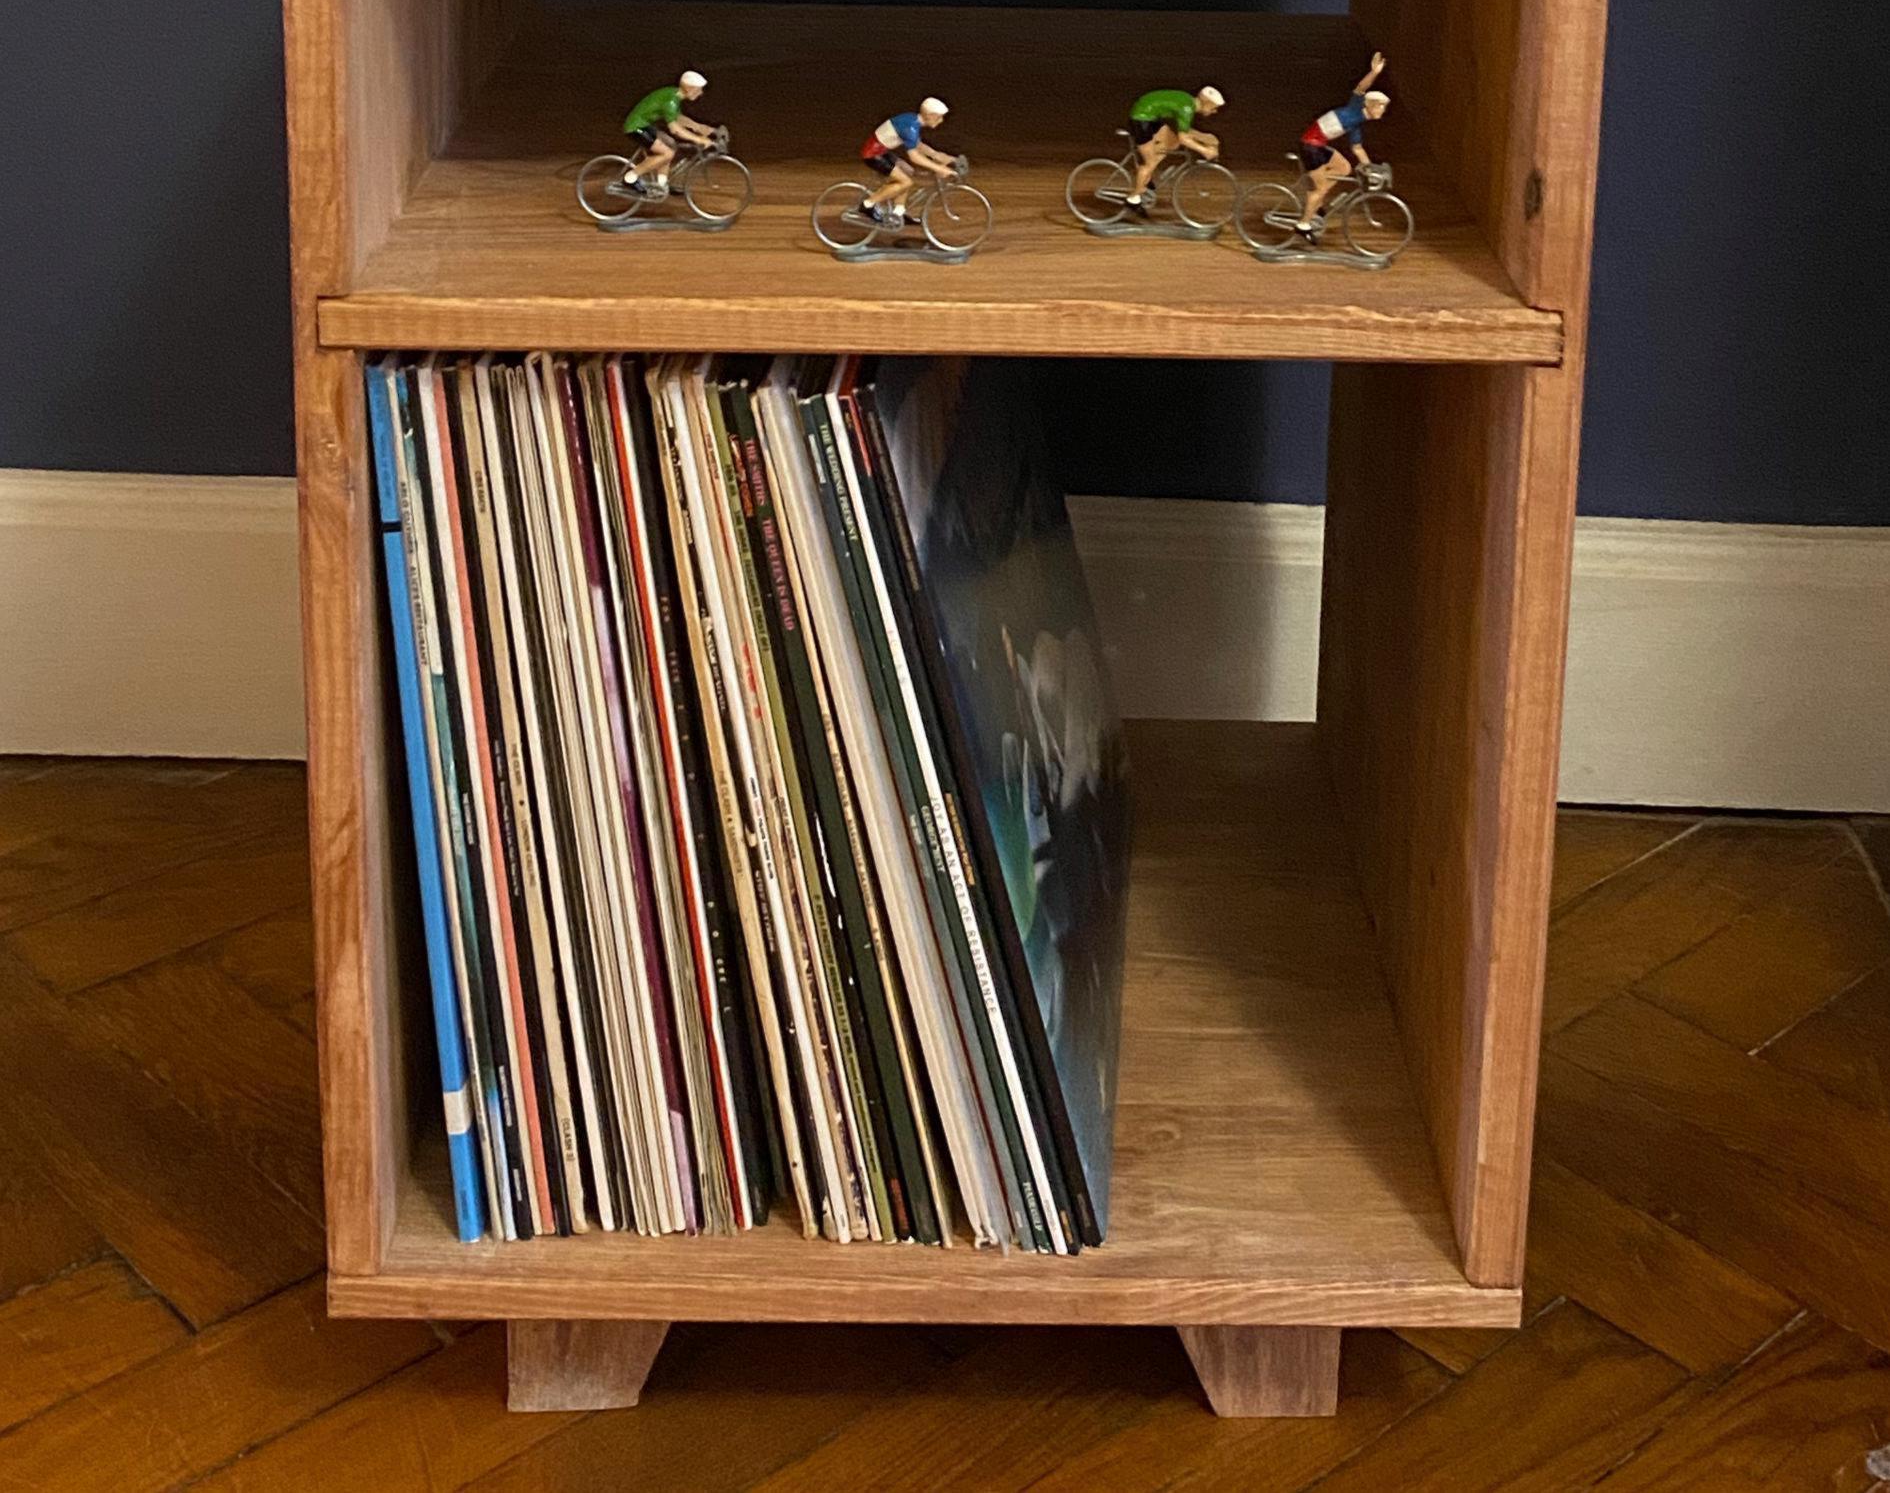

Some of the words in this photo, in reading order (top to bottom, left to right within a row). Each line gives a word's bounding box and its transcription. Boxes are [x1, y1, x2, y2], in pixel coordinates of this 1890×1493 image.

[745, 438, 757, 460] THE
[751, 463, 766, 506] SMITHS
[819, 424, 829, 445] THE
[825, 445, 846, 494] WEDDING
[839, 494, 859, 541] PRESENT
[762, 517, 774, 540] THE
[766, 542, 784, 583] QUEEN
[780, 597, 794, 631] DEAD
[721, 785, 732, 815] CLASH
[513, 759, 522, 786] CLASH
[521, 818, 531, 853] LONDON
[527, 853, 537, 888] CALLING
[920, 805, 937, 844] GEORGE
[933, 844, 946, 873] BEST
[930, 795, 945, 819] JOY
[939, 827, 951, 844] AS
[945, 851, 955, 870] AN
[951, 873, 967, 898] ACT
[959, 906, 973, 924] OF
[966, 928, 998, 1014] RESISTANCE
[560, 1117, 574, 1152] (CLASH
